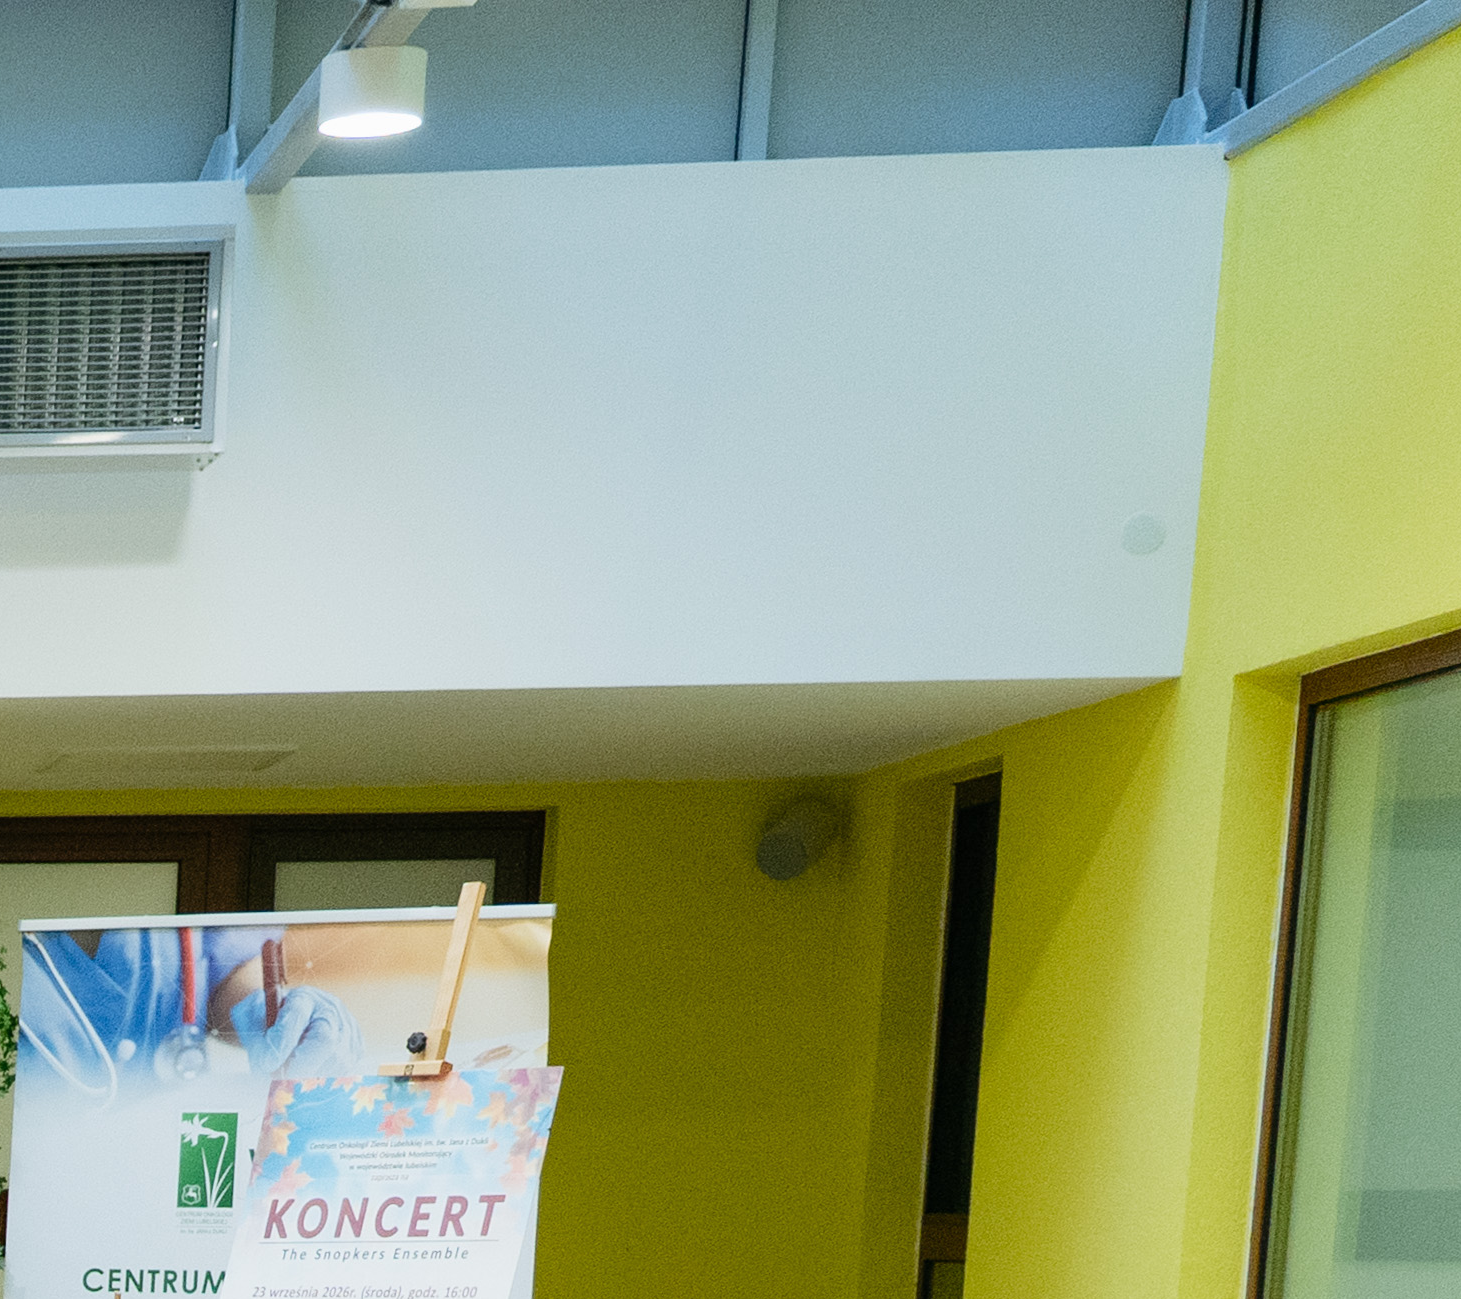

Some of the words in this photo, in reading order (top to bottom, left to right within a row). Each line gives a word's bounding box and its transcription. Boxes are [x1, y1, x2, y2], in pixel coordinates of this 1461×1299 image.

[263, 1194, 506, 1239] KONCERT
[281, 1248, 307, 1260] The
[314, 1248, 386, 1263] Snopkers
[393, 1246, 469, 1260] Ensemble
[82, 1268, 226, 1294] CENTRUM
[252, 1286, 266, 1298] 23
[269, 1285, 318, 1298] września
[322, 1286, 356, 1298] 2026r.
[444, 1286, 478, 1298] 16:00
